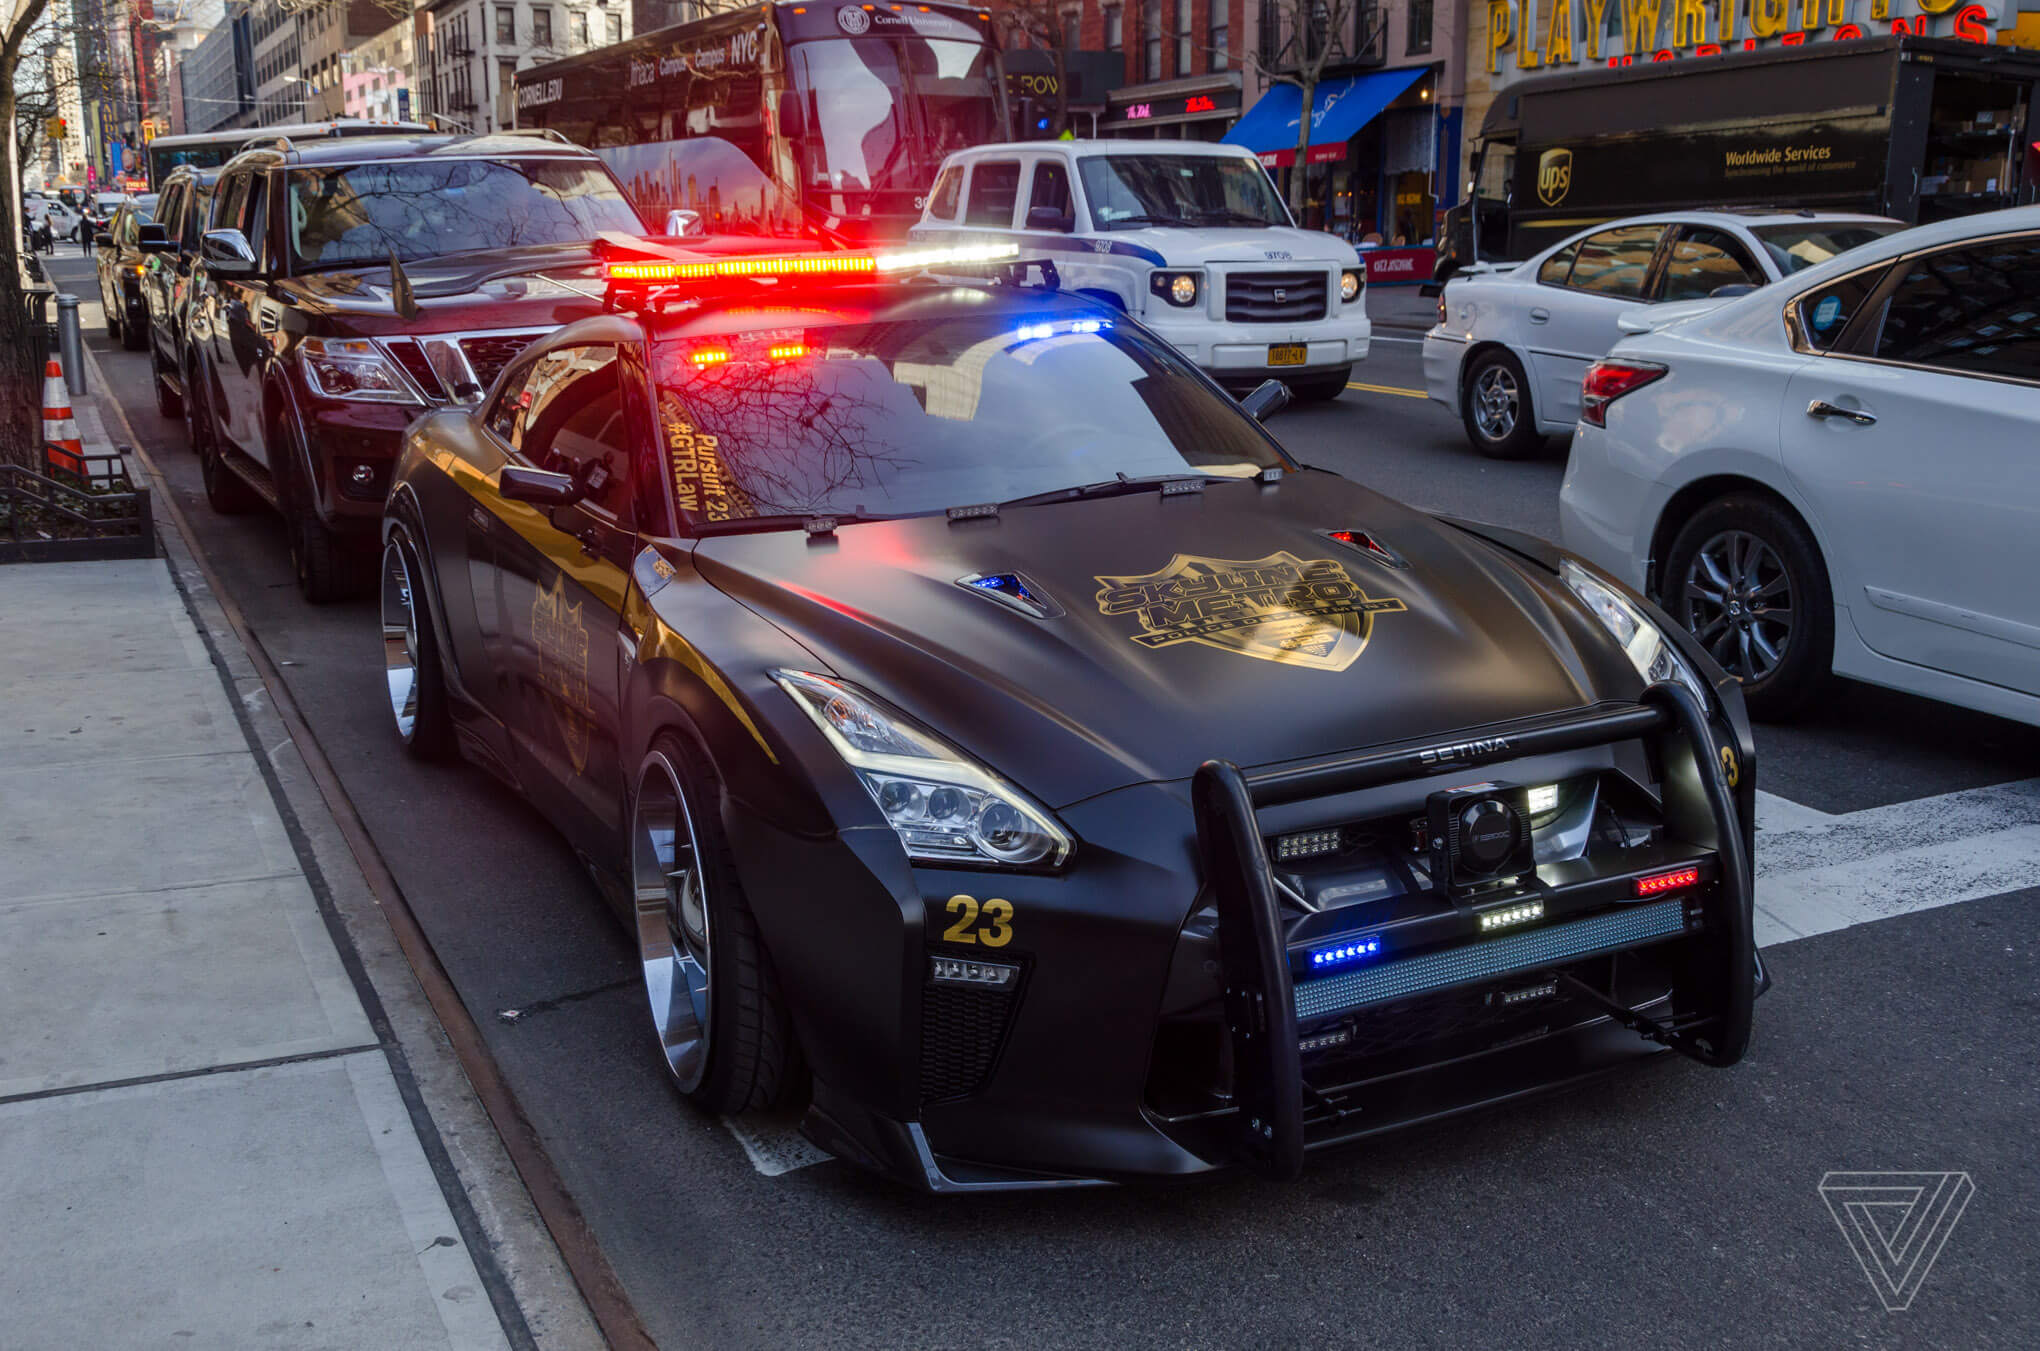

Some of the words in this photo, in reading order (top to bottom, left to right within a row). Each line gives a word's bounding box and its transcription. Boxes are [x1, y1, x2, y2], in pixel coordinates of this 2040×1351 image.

[659, 56, 687, 77] Campus
[695, 47, 725, 70] Campus
[731, 30, 758, 65] NYC
[518, 78, 563, 109] CORNELL.EDU
[1726, 147, 1782, 166] Worldwide
[1784, 144, 1832, 162] Services
[1541, 165, 1569, 199] ups
[668, 422, 699, 511] #GTRLaw
[695, 433, 726, 496] Pursuit
[706, 501, 730, 522] 23
[1102, 560, 1345, 613] SKYLINE
[1146, 582, 1357, 628] METRO
[1152, 618, 1237, 645] POLICE
[1247, 601, 1392, 627] DEPARTMENT
[1420, 738, 1510, 764] SETINA
[943, 894, 1014, 948] 23
